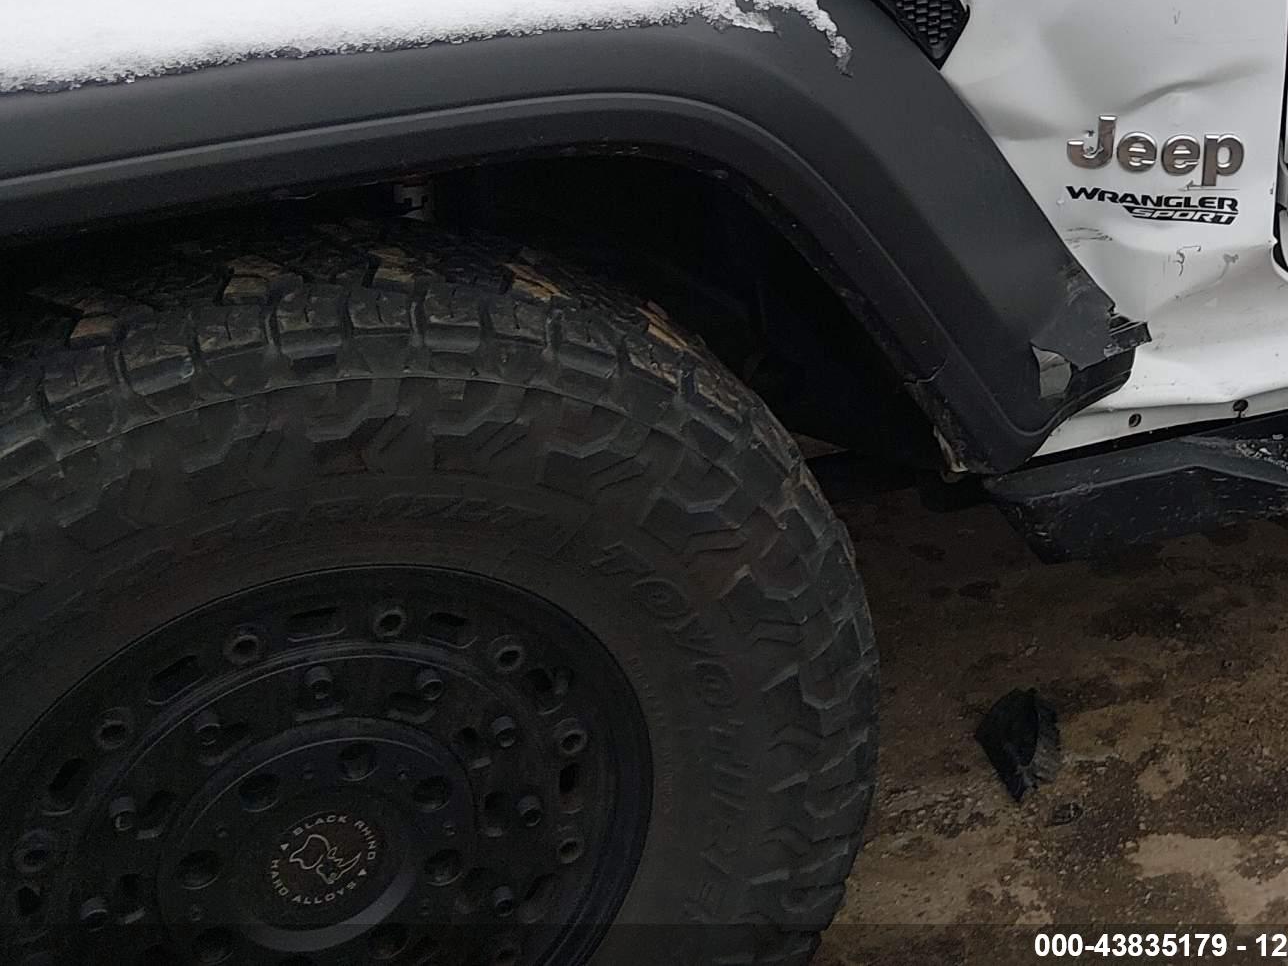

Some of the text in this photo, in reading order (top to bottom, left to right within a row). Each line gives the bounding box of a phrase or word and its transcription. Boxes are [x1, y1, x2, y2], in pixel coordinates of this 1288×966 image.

[1067, 115, 1245, 186] Jeep
[1066, 186, 1239, 211] WRANGLER
[1131, 209, 1237, 224] SPORT
[292, 816, 377, 860] BLACK RHINO
[270, 859, 357, 904] HARD ALLOYS
